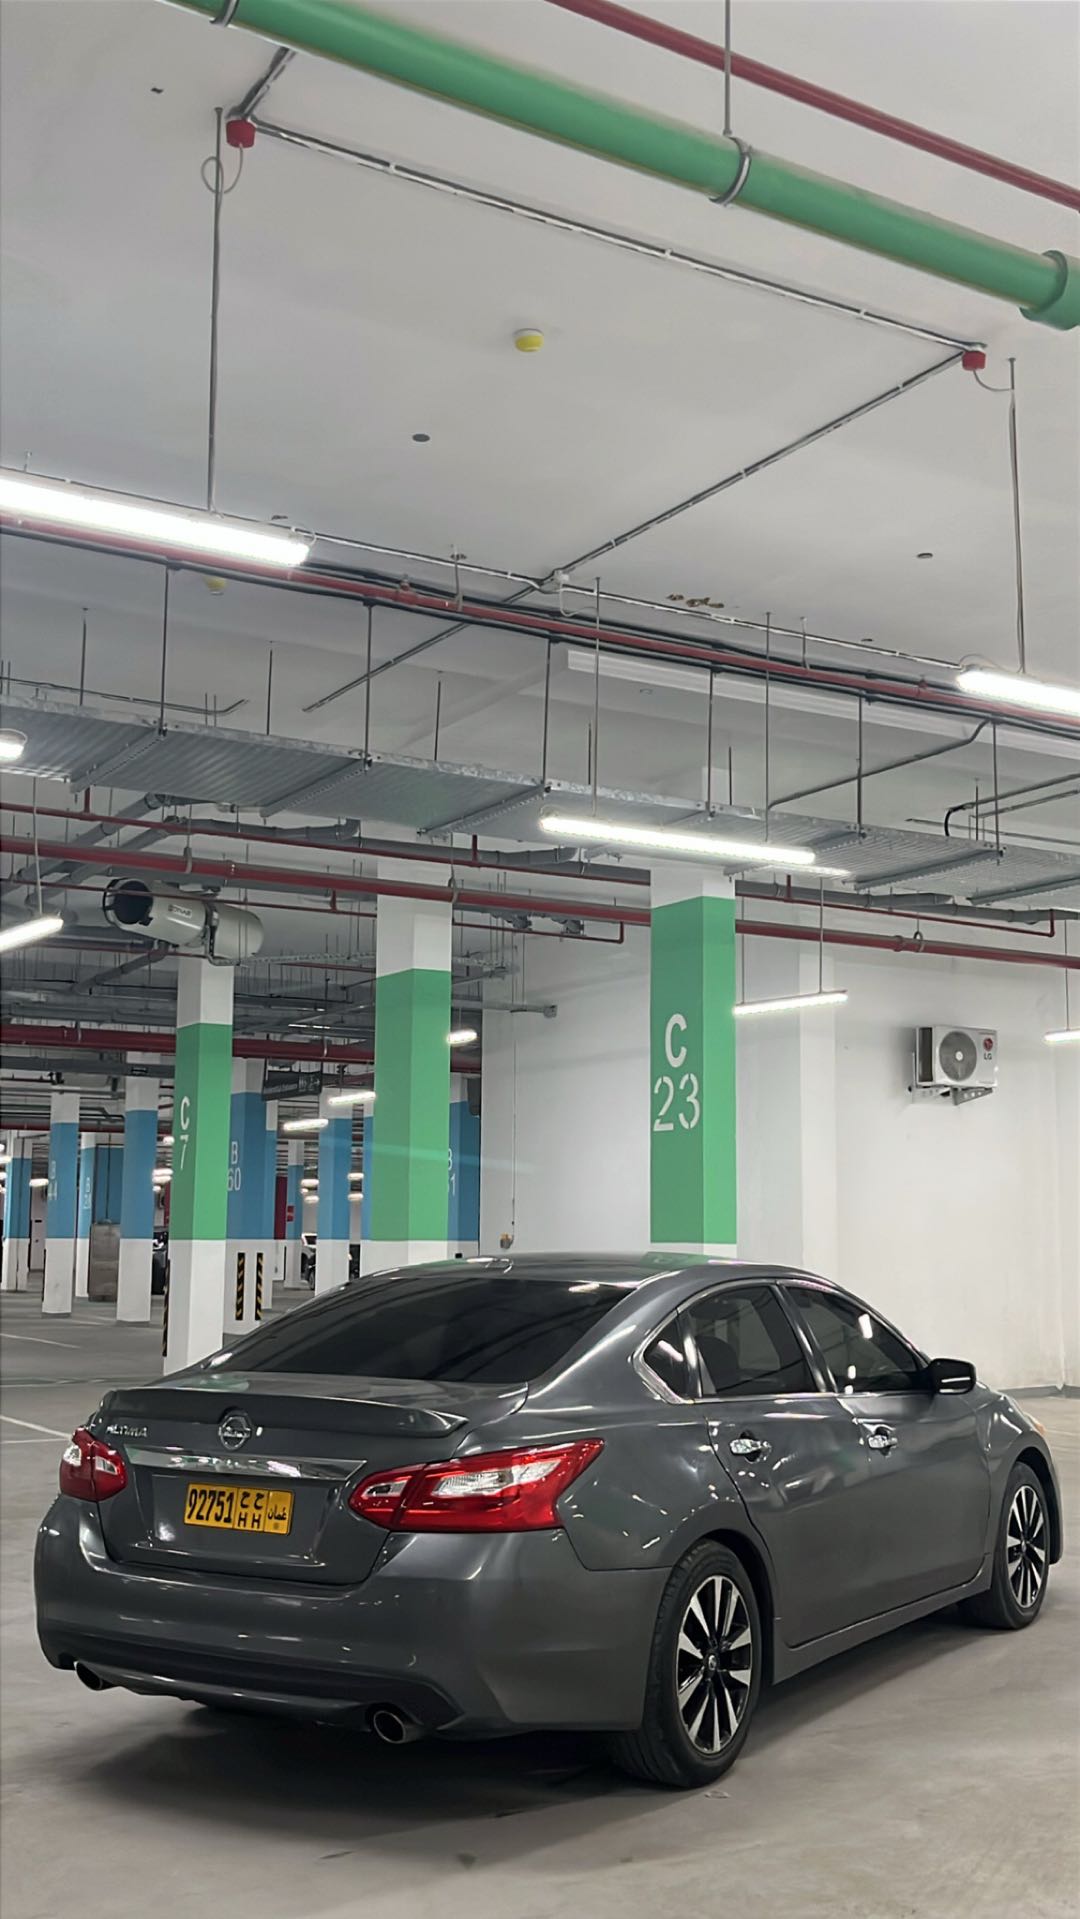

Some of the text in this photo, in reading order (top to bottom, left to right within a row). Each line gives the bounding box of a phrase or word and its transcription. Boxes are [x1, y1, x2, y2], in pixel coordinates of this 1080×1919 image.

[664, 1013, 688, 1068] C
[983, 1052, 992, 1060] LG
[180, 1095, 191, 1131] C
[653, 1073, 701, 1131] 23
[180, 1134, 190, 1171] 7
[230, 1141, 239, 1165] B
[187, 1488, 235, 1523] 92751
